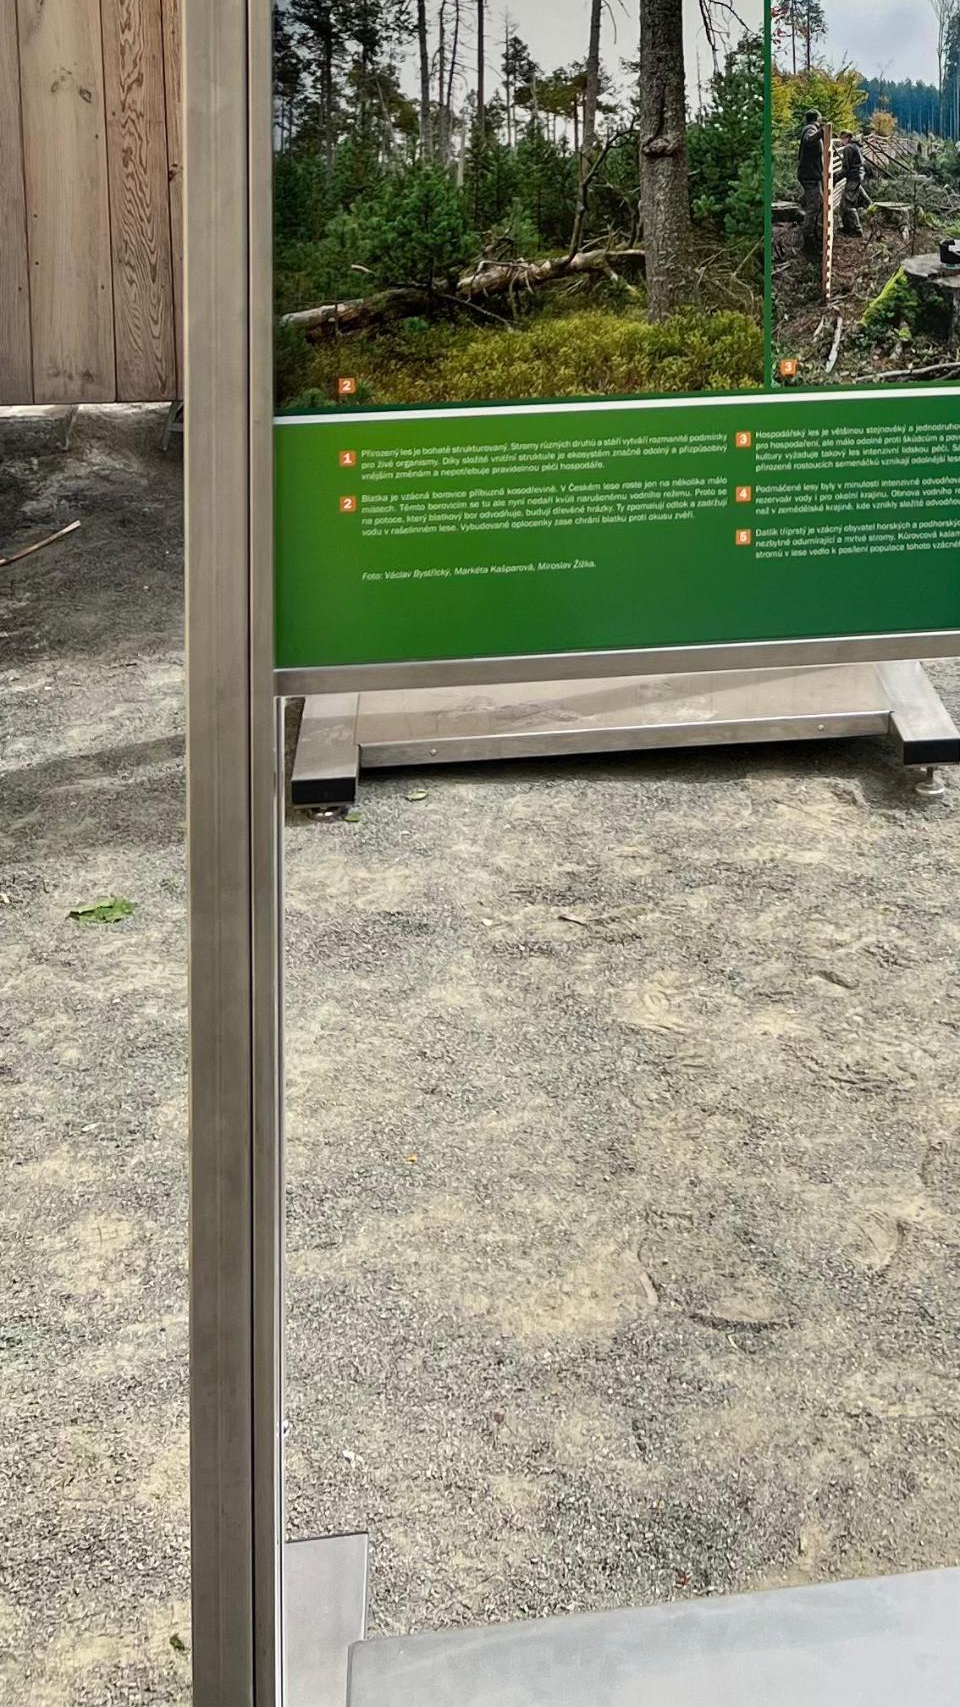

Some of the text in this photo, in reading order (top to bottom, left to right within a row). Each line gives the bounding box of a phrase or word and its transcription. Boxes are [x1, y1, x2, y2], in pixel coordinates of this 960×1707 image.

[785, 361, 792, 371] 3
[343, 380, 351, 391] 2
[821, 427, 828, 437] je
[740, 434, 747, 444] 3
[756, 442, 768, 451] pro
[822, 438, 833, 446] ale
[835, 437, 854, 445] málo
[856, 436, 882, 444] odolné
[884, 435, 901, 445] proti
[344, 453, 352, 463] 1
[821, 448, 846, 458] takový
[361, 493, 388, 502] Blatka
[390, 492, 398, 502] je
[401, 491, 429, 500] vzácná
[568, 481, 600, 491] Českém
[622, 480, 642, 488] roste
[644, 479, 656, 489] jen
[707, 476, 727, 484] málo
[803, 482, 818, 491] lesy
[820, 481, 835, 491] byly
[739, 488, 747, 498] 4
[794, 493, 812, 503] vody
[819, 493, 832, 502] pro
[834, 491, 857, 499] okolní
[891, 489, 919, 497] Obnova
[344, 498, 352, 509] 2
[756, 506, 769, 514] než
[856, 501, 870, 509] kde
[755, 527, 778, 536] Datlík
[807, 525, 814, 535] je
[816, 524, 842, 534] vzácný
[740, 532, 747, 542] 5
[844, 534, 866, 542] mrtvé
[755, 549, 782, 558] stromů
[809, 547, 829, 555] vedlo
[906, 541, 930, 550] tohoto
[385, 570, 411, 578] Václav
